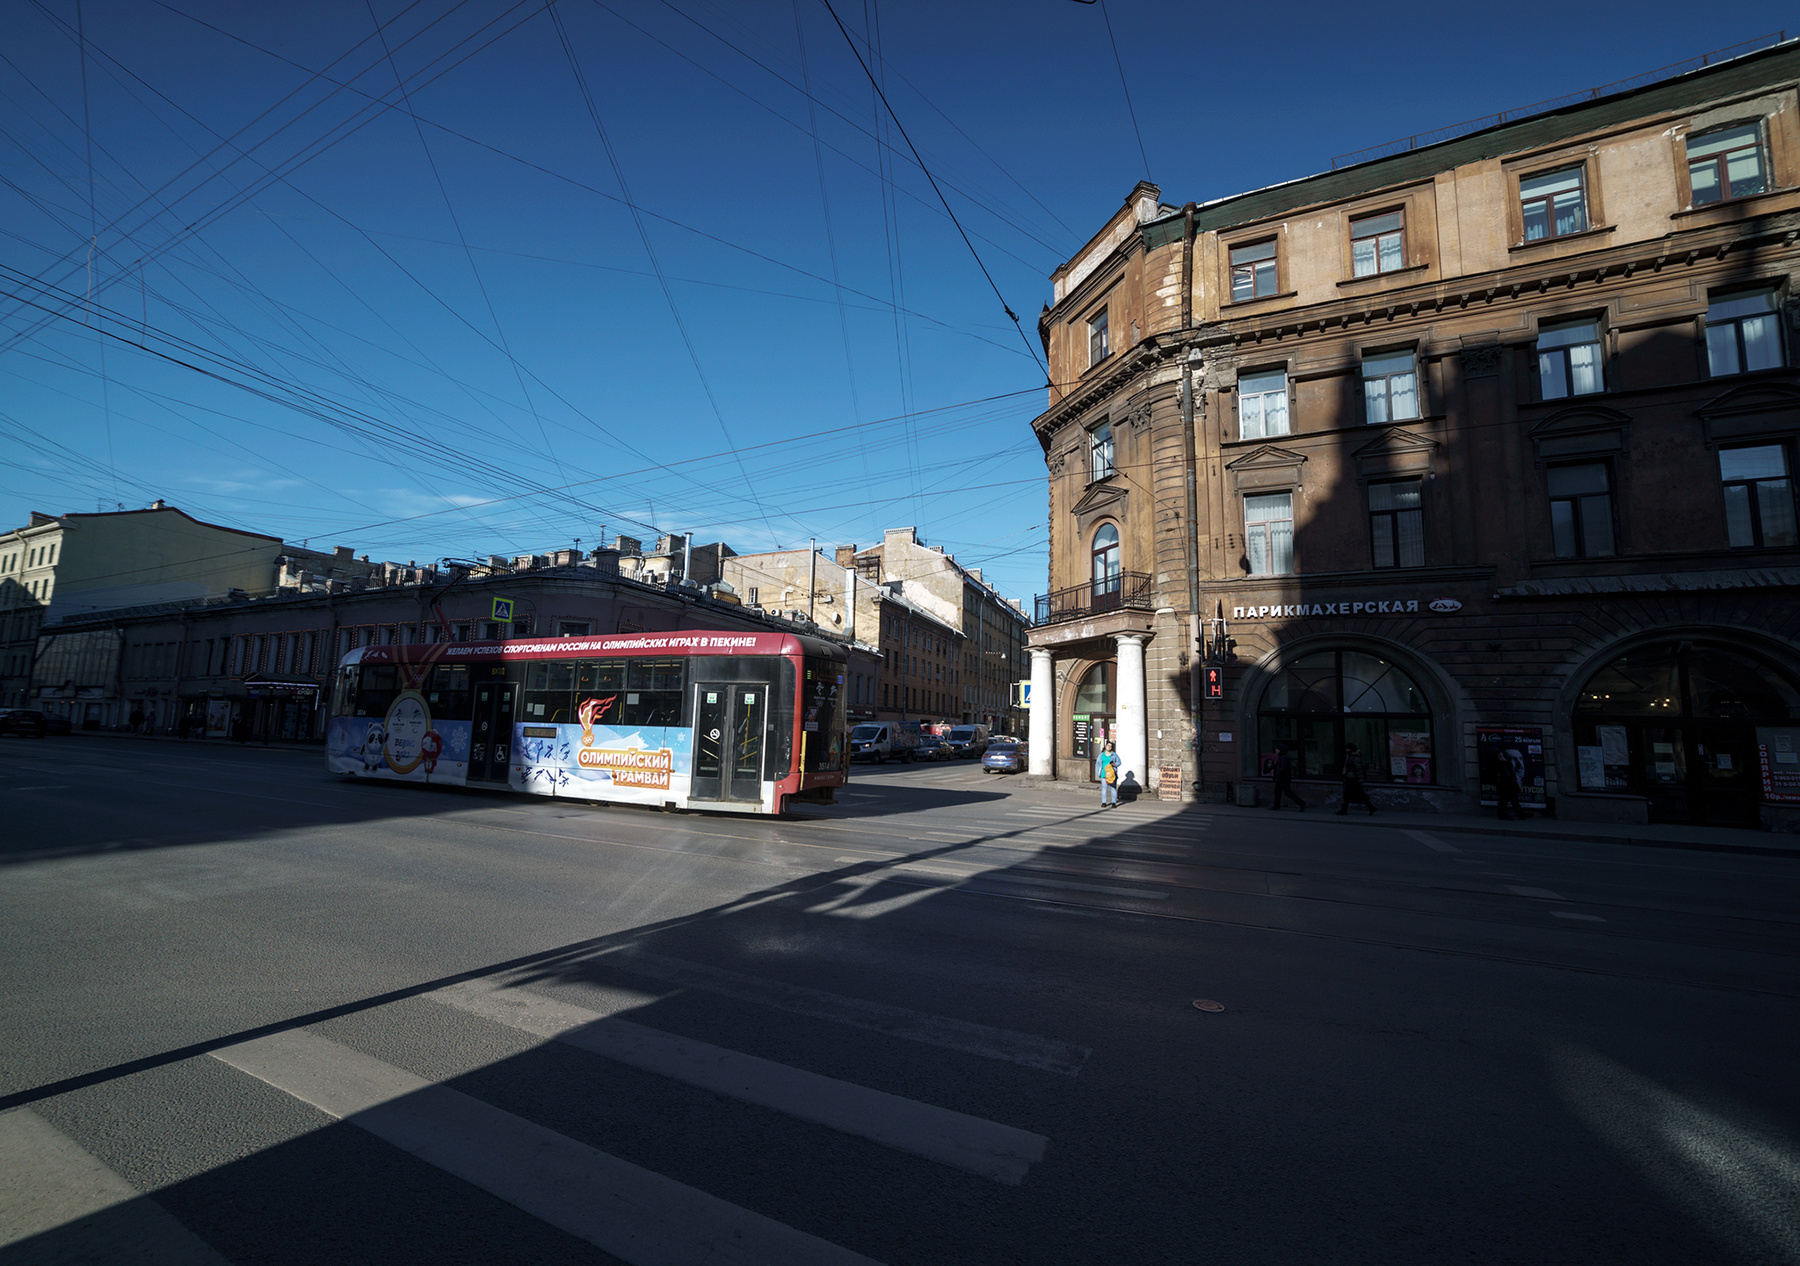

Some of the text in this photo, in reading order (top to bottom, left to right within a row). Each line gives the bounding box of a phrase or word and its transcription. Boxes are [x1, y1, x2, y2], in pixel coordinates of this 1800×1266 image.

[1233, 600, 1419, 619] ПАРИКМАХЕРСКАЯ
[446, 637, 756, 656] ЖЕЛАЕМ УСПЕХОВ СПОРТСМЕНАМ РОССИИ НА ОЛИМПИЙСКИХ ИГРАХ В ПЕКИНЕ!
[580, 751, 669, 769] ОЛИМПИЙСКИЙ
[1758, 744, 1772, 792] СОЛЯРИЙ
[614, 769, 668, 786] ТРАМВАЙ
[1520, 786, 1545, 794] УТУСОВ
